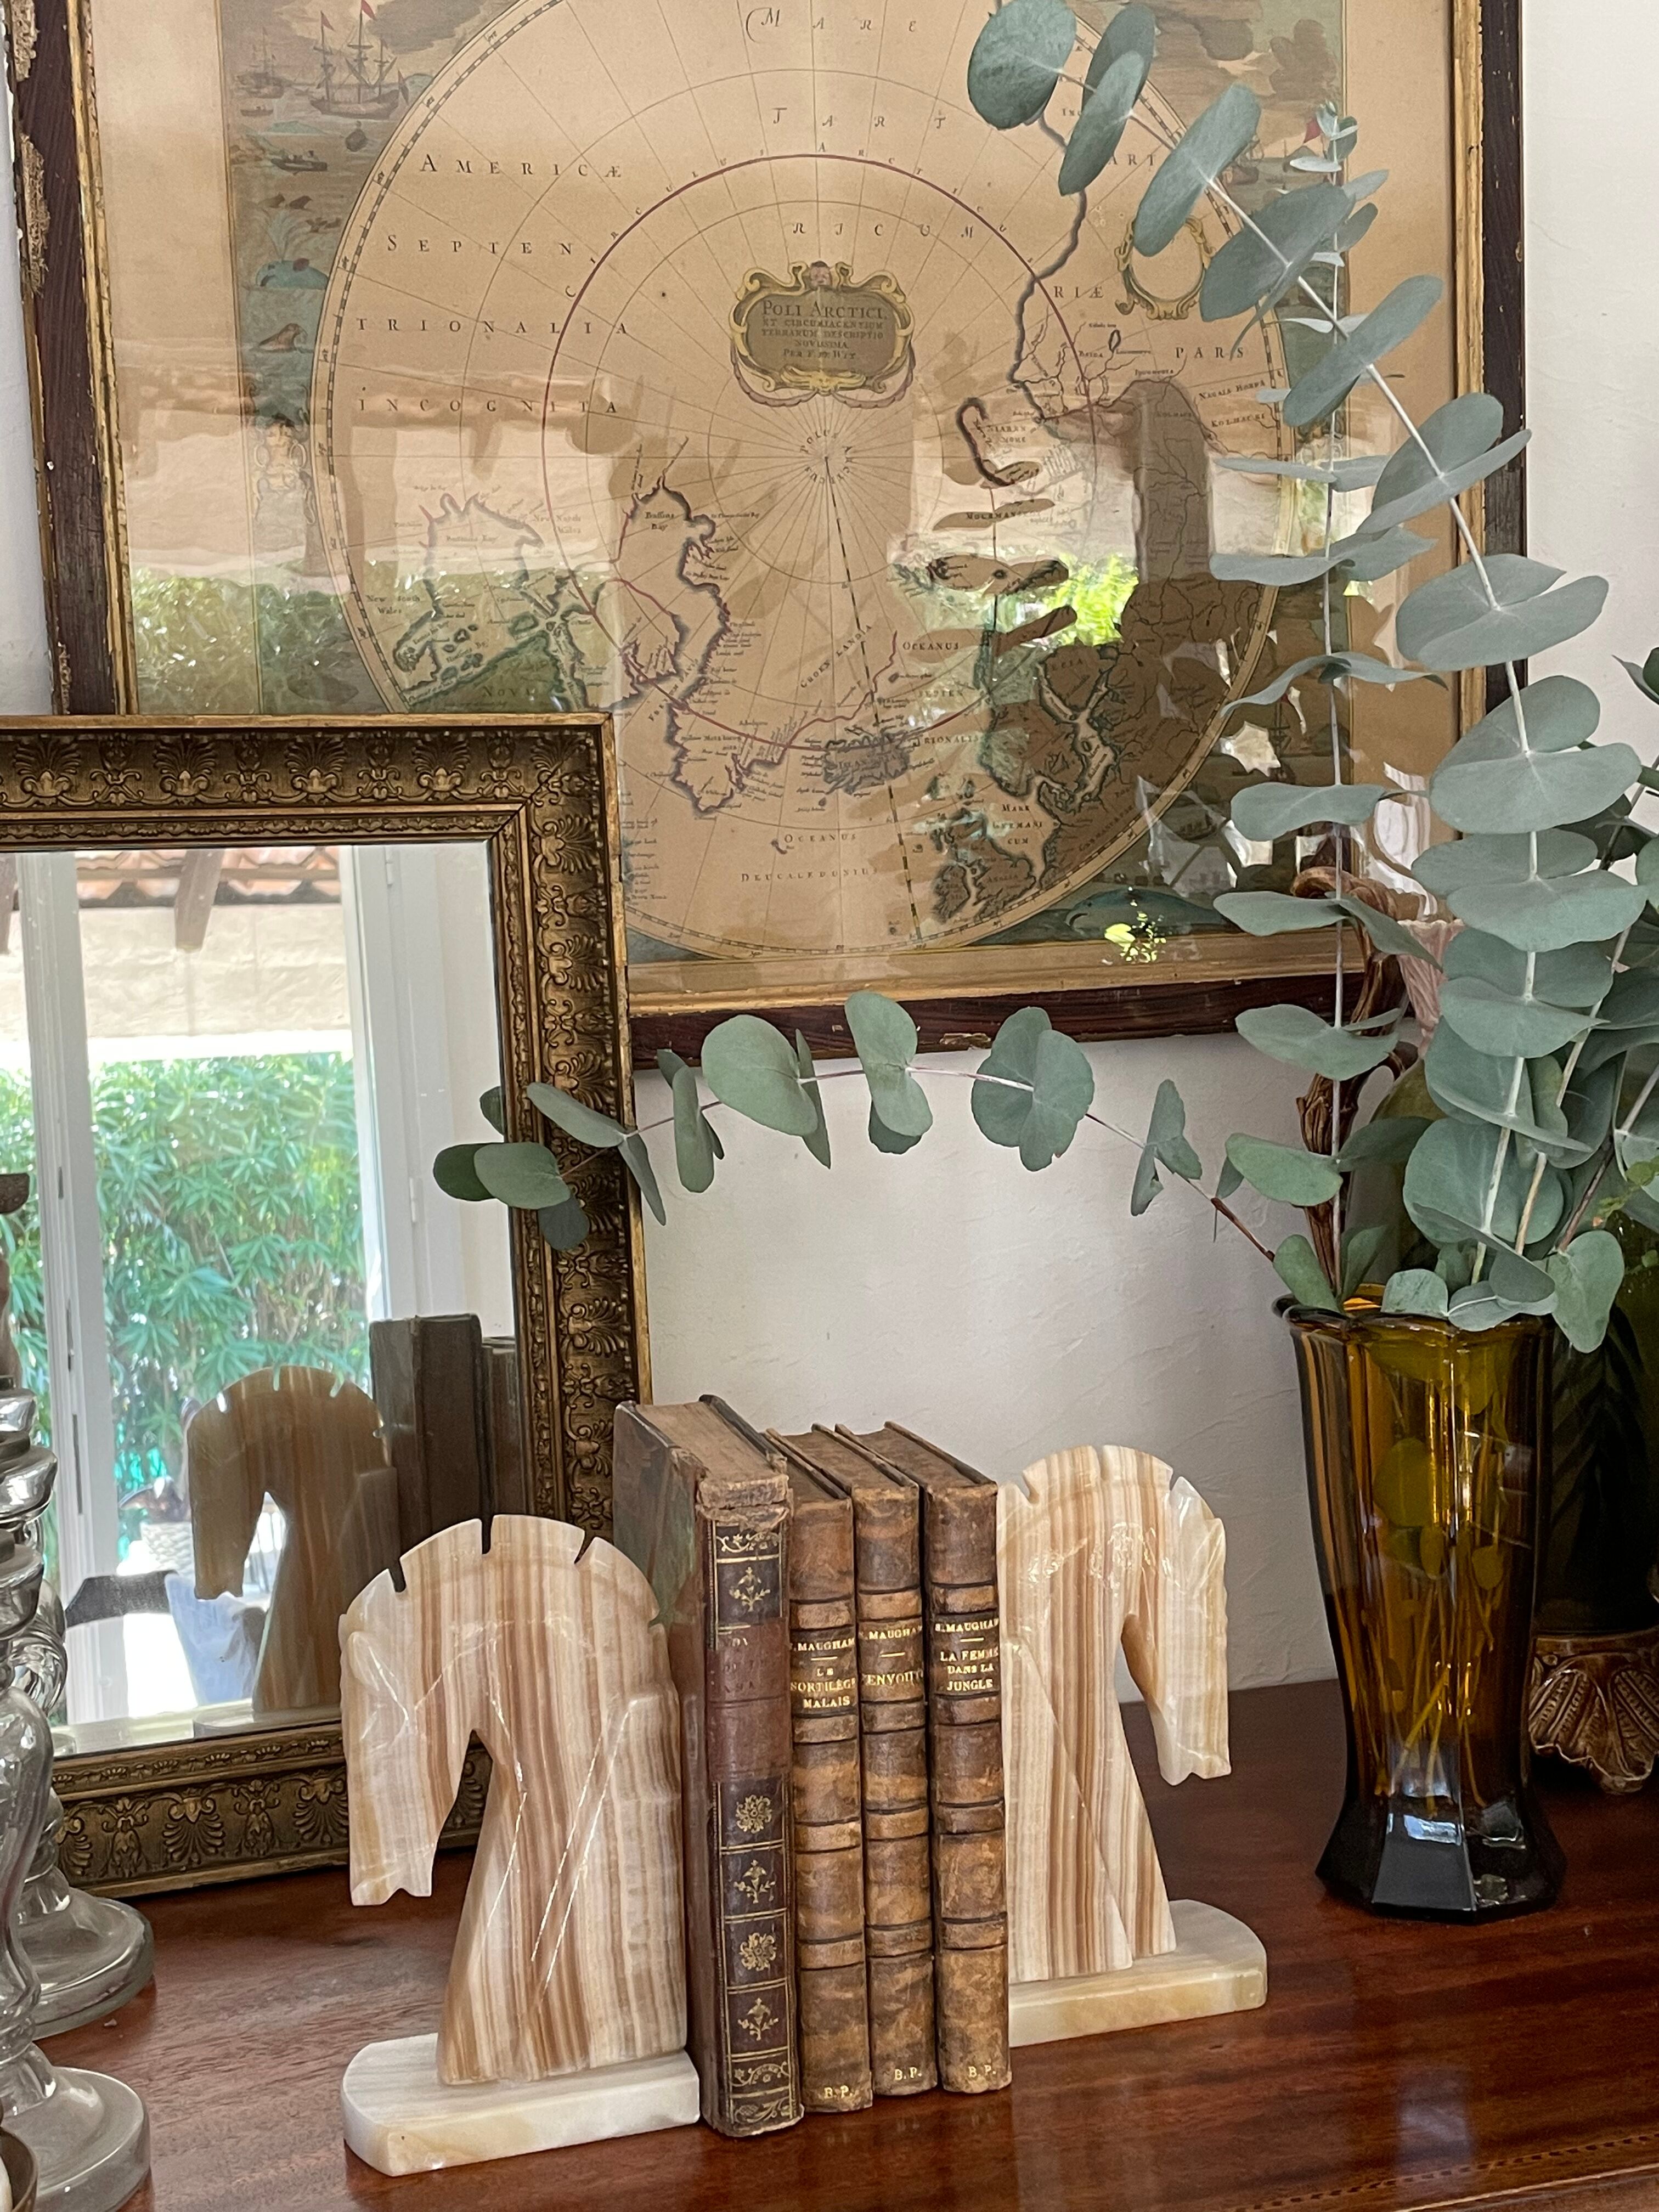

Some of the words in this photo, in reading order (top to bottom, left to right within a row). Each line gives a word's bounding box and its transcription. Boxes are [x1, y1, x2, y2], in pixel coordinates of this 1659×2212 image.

[747, 7, 916, 40] MARE
[387, 235, 573, 255] SEPTEN
[763, 300, 802, 317] POLI
[356, 318, 627, 334] TRIONALIA
[1176, 347, 1244, 358] PARS
[359, 398, 617, 414] INCOGNITA
[940, 1651, 957, 1662] LA
[947, 1665, 977, 1674] DANS
[980, 1663, 994, 1672] LA
[946, 1679, 993, 1691] JUNGLE
[803, 1696, 850, 1708] MALAIS
